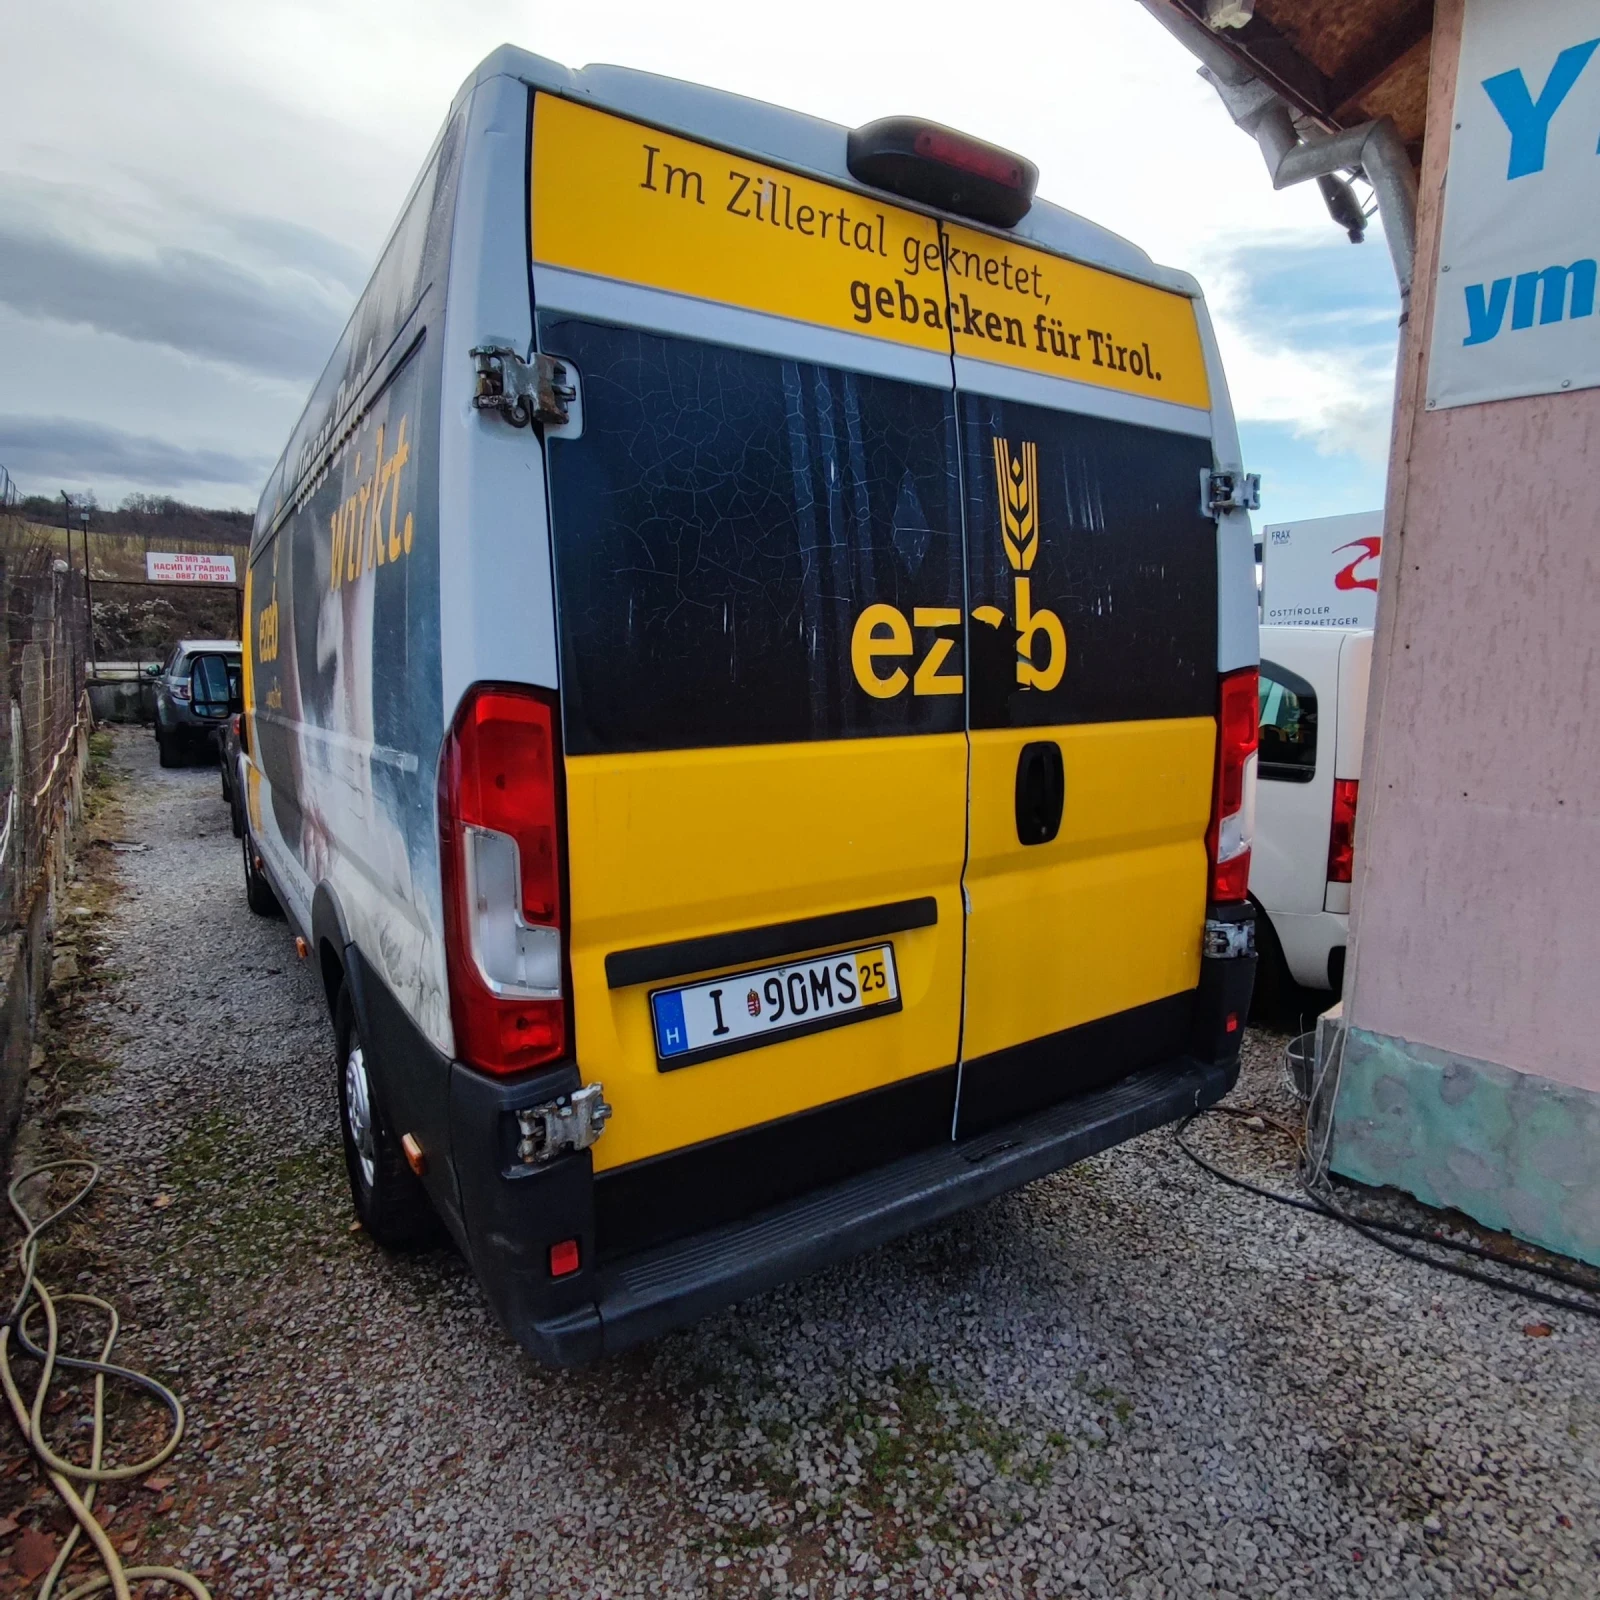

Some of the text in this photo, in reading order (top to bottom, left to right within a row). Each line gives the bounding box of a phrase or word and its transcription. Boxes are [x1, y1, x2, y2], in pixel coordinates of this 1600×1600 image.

[1481, 38, 1600, 180] Y
[640, 144, 1050, 306] Im Zillertal geknetet,
[850, 279, 1162, 381] gebacken für Tirol.
[330, 414, 413, 592] wirkt.
[1271, 530, 1291, 540] FRAX
[153, 563, 183, 571] НАСИП
[194, 565, 231, 573] ГРАДИНА
[174, 555, 211, 564] ЗЕМЯ ЗА
[176, 572, 196, 580] 0887
[1269, 606, 1330, 618] OSTTIROLER
[709, 989, 730, 1036] I
[859, 962, 886, 992] 25
[665, 1027, 680, 1046] H
